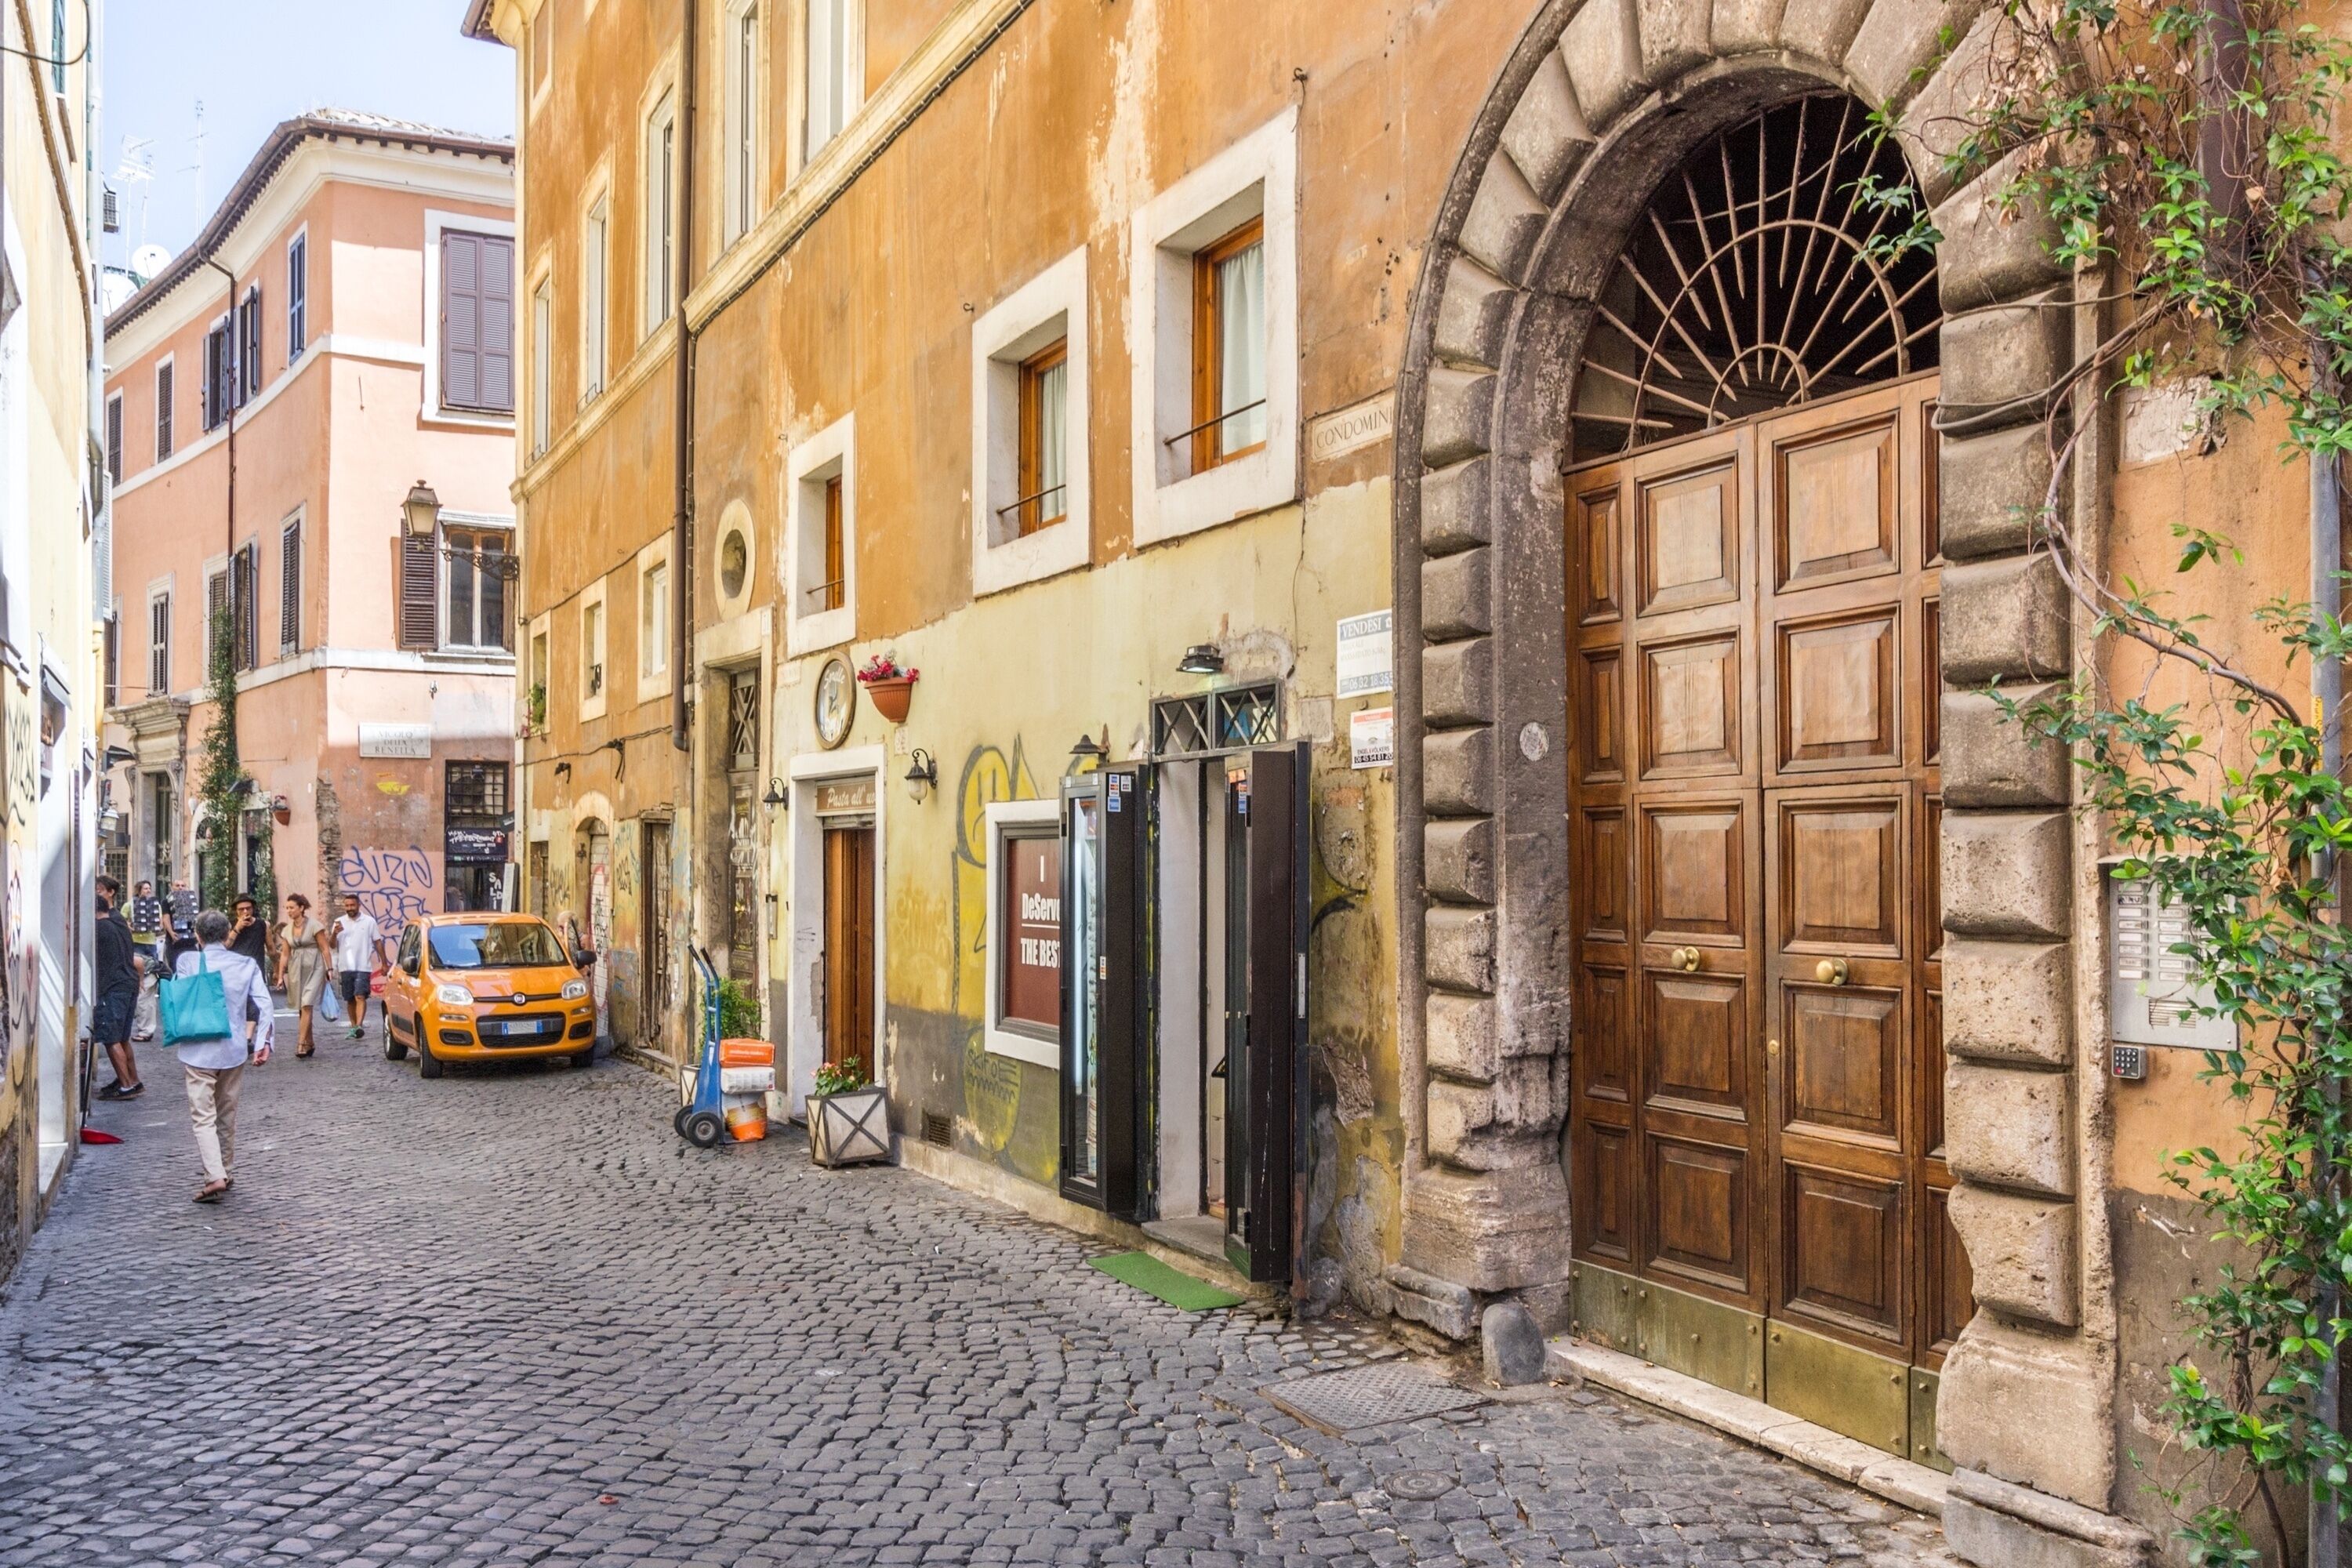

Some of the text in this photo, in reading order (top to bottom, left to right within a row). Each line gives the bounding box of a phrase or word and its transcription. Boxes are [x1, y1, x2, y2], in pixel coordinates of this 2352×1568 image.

[1342, 617, 1381, 638] VENDESI
[1349, 678, 1358, 690] 06
[827, 787, 850, 808] Pasta
[1040, 855, 1044, 882] I
[1021, 938, 1038, 966] THE
